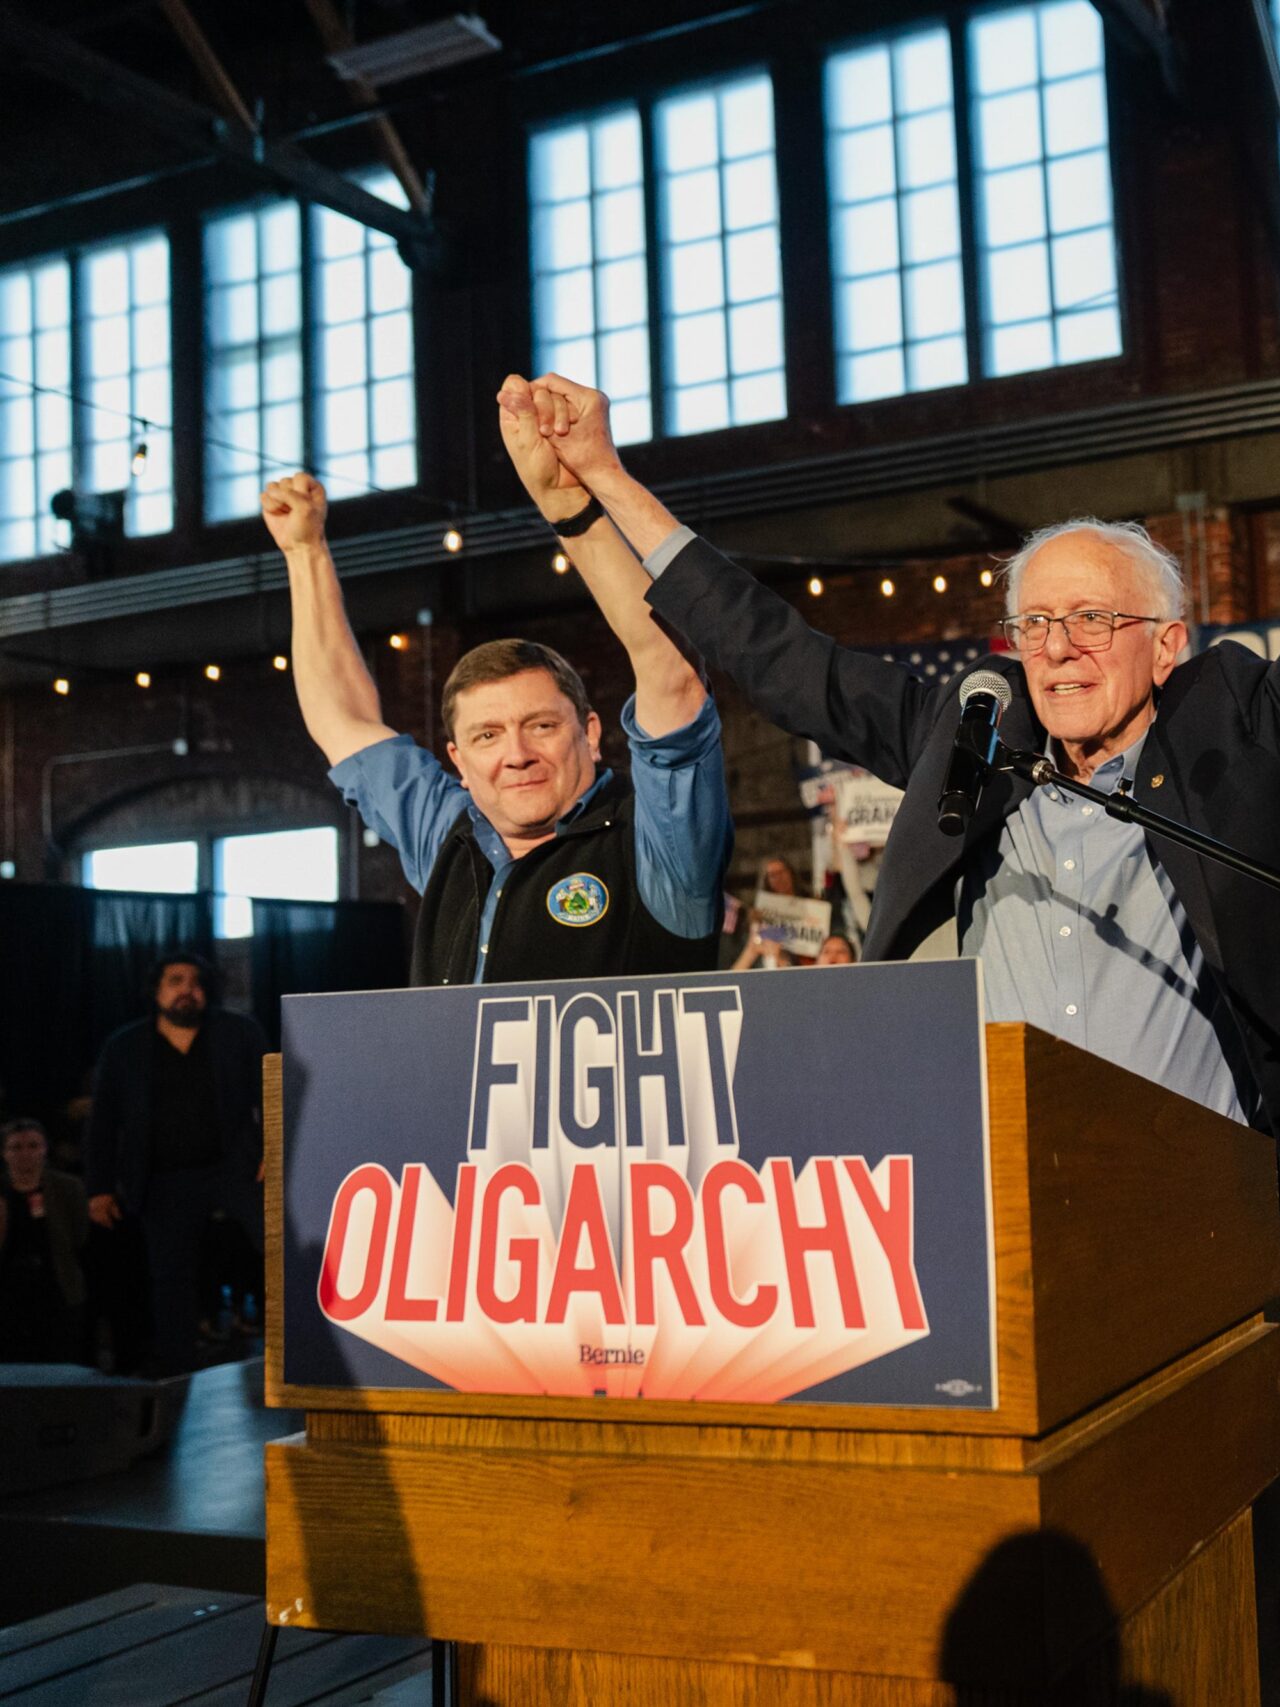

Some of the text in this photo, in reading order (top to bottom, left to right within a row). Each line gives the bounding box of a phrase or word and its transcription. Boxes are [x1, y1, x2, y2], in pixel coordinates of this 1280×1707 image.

[848, 806, 896, 824] GRAH
[468, 985, 742, 1152] FIGHT
[317, 1155, 928, 1331] OLIGARCHY
[579, 1344, 645, 1366] Bernie
